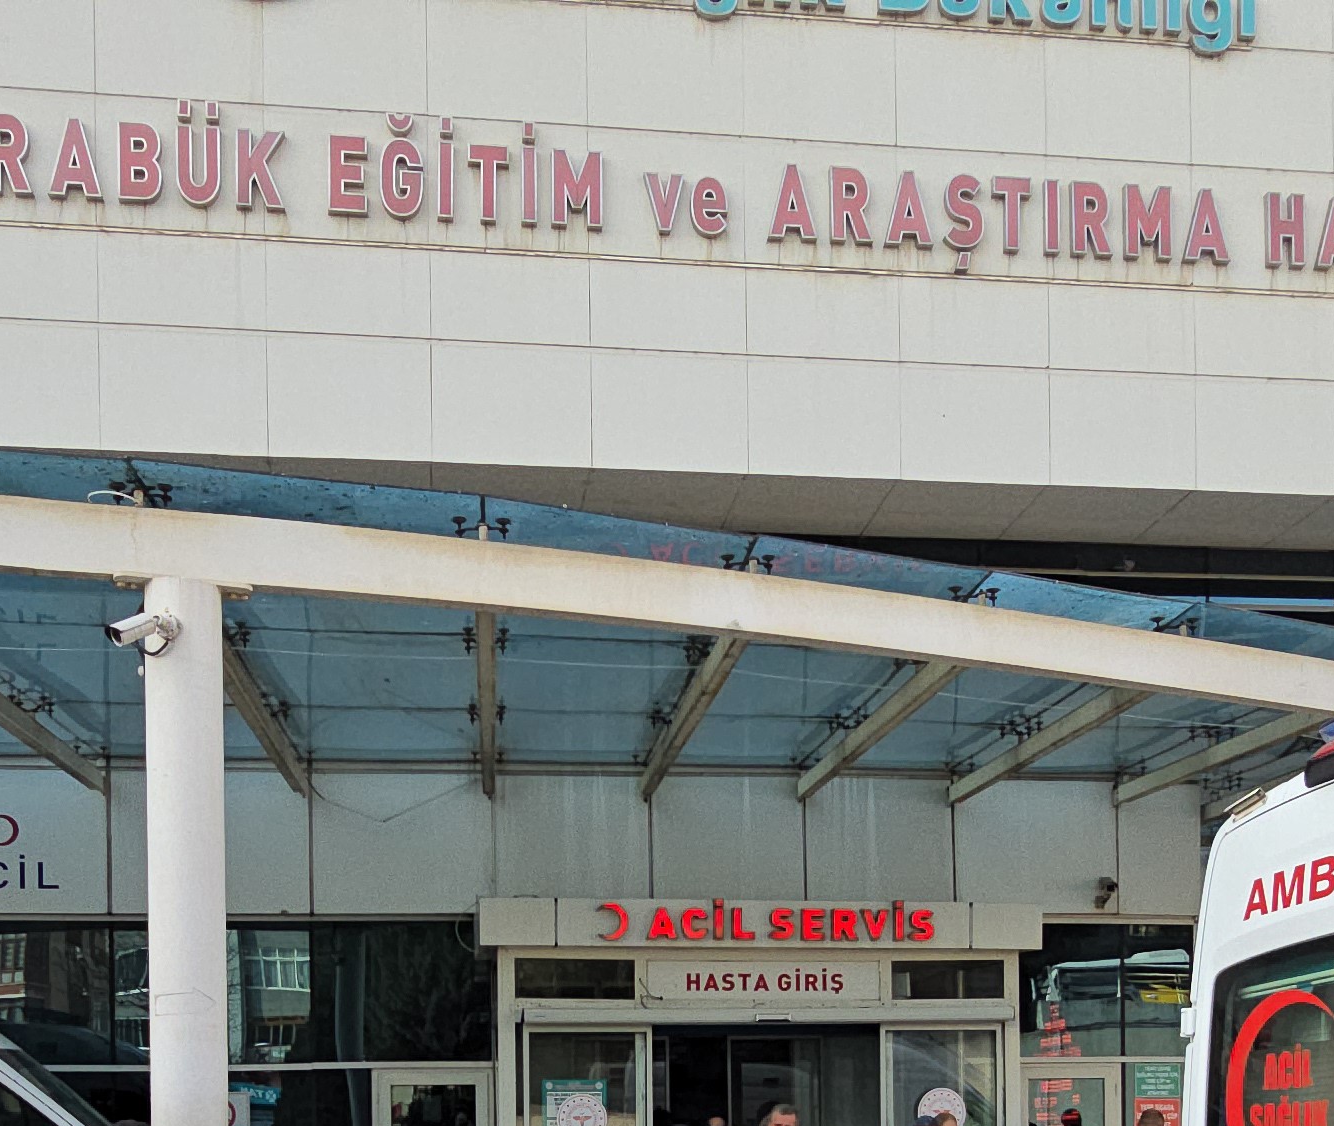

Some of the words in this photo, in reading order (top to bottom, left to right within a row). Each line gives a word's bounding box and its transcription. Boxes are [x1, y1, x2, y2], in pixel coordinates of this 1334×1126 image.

[327, 112, 603, 232] EĞİTİM
[644, 170, 729, 239] ve
[768, 163, 1230, 274] ARAŞTIRMA
[648, 899, 755, 941] ACİL
[769, 899, 935, 942] SERVİS
[685, 972, 770, 994] HASTA
[775, 967, 845, 996] GİRİŞ
[1262, 1042, 1315, 1091] ACİL
